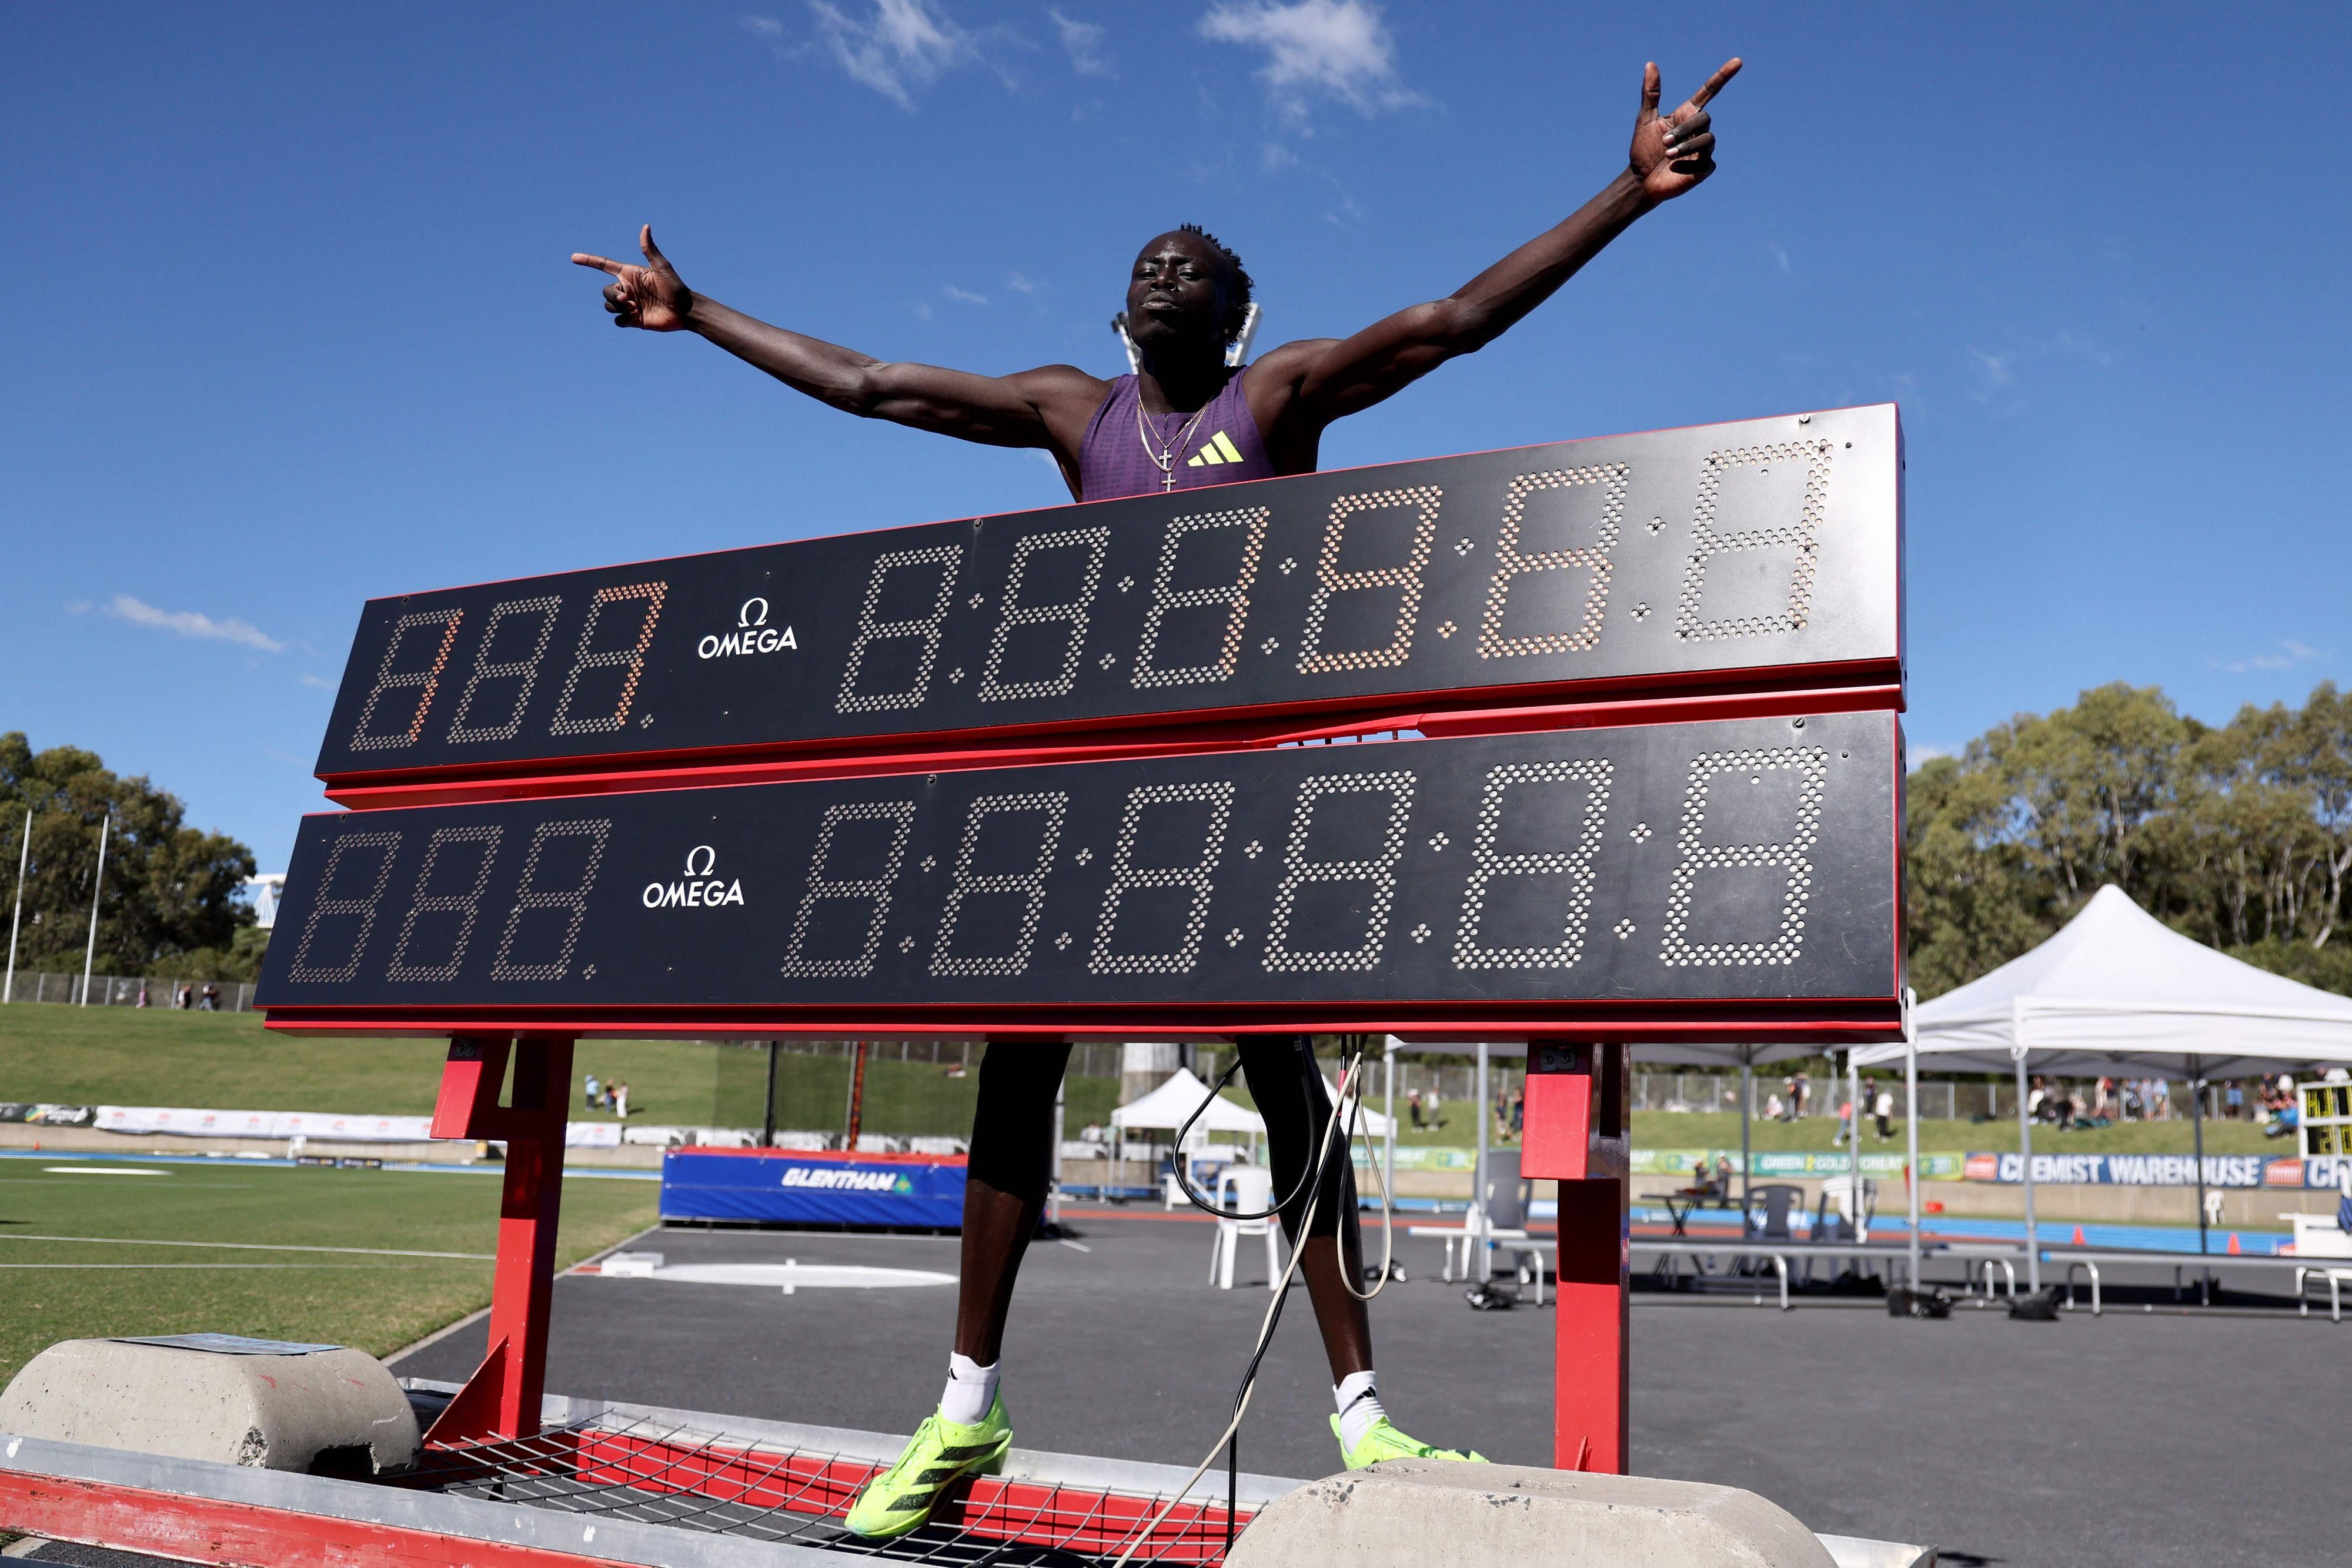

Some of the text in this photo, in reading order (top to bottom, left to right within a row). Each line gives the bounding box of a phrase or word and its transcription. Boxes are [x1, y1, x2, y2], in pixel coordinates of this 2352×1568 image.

[697, 625, 798, 659] OMEGA
[642, 878, 744, 910] OMEGA
[781, 1168, 897, 1191] GLENTHAM
[2108, 1155, 2261, 1186] WAREHOUSE
